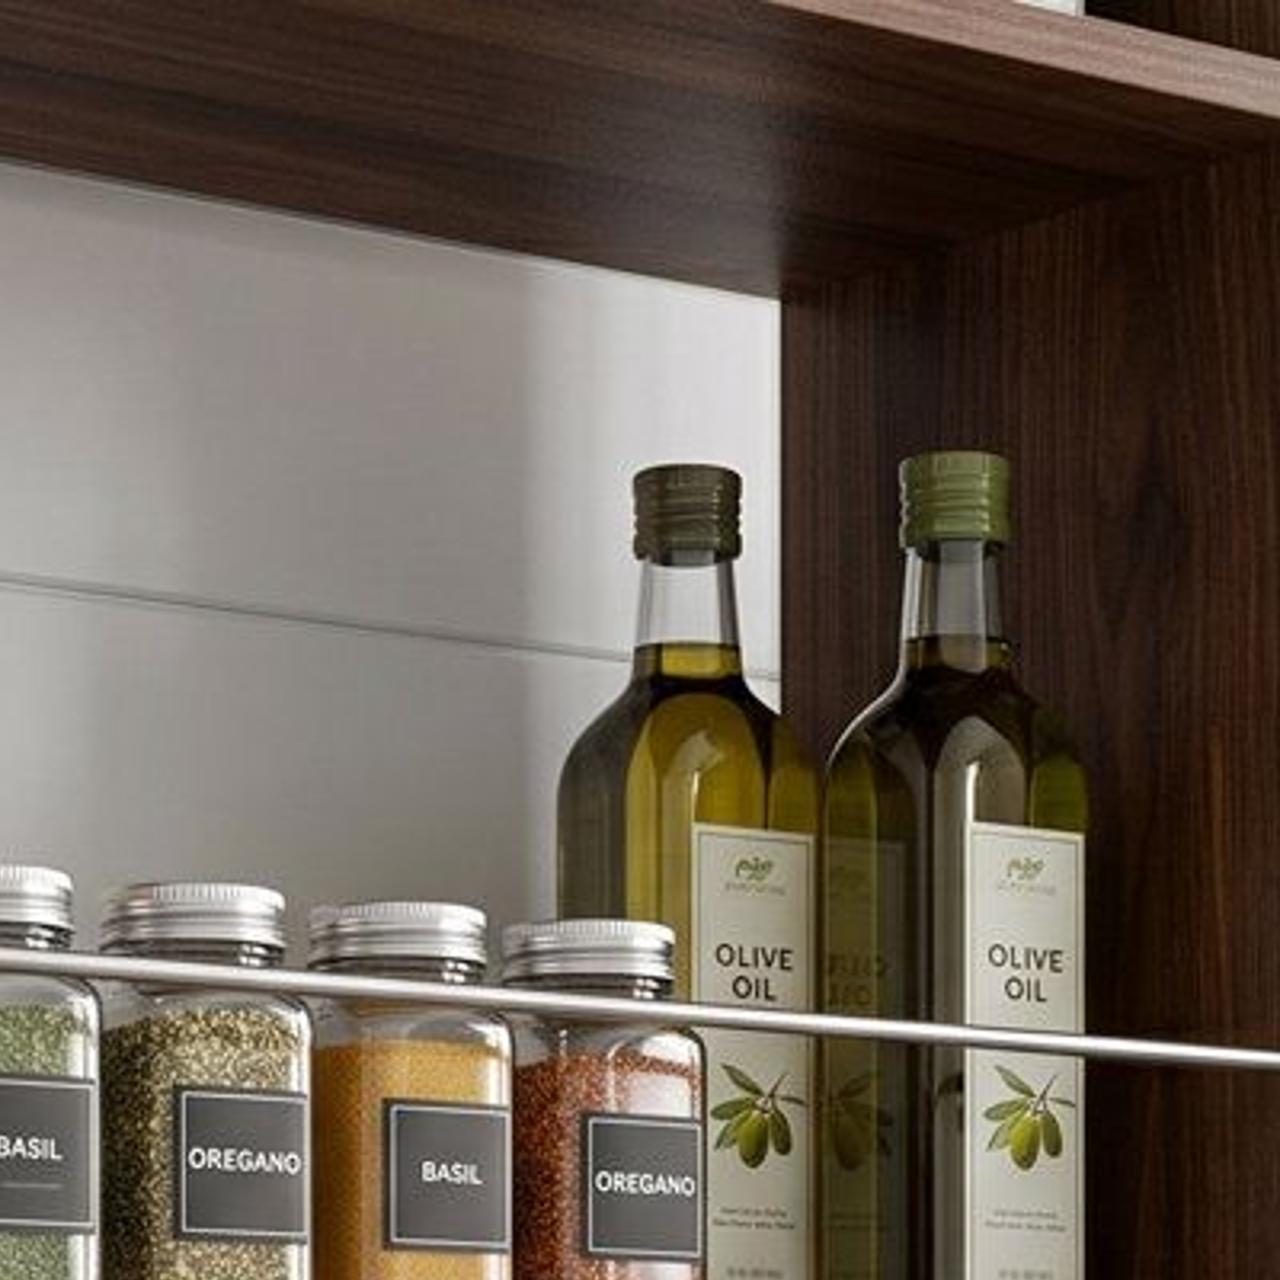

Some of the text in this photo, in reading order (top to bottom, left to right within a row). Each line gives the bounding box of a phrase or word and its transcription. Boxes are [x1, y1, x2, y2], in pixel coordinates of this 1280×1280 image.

[715, 943, 794, 971] OLIVE
[988, 943, 1063, 973] OLIVE
[732, 975, 777, 1002] OIL
[1004, 976, 1047, 1003] OIL
[188, 1147, 302, 1175] OREGANO
[421, 1160, 483, 1186] BASIL
[595, 1170, 696, 1198] OREGANO
